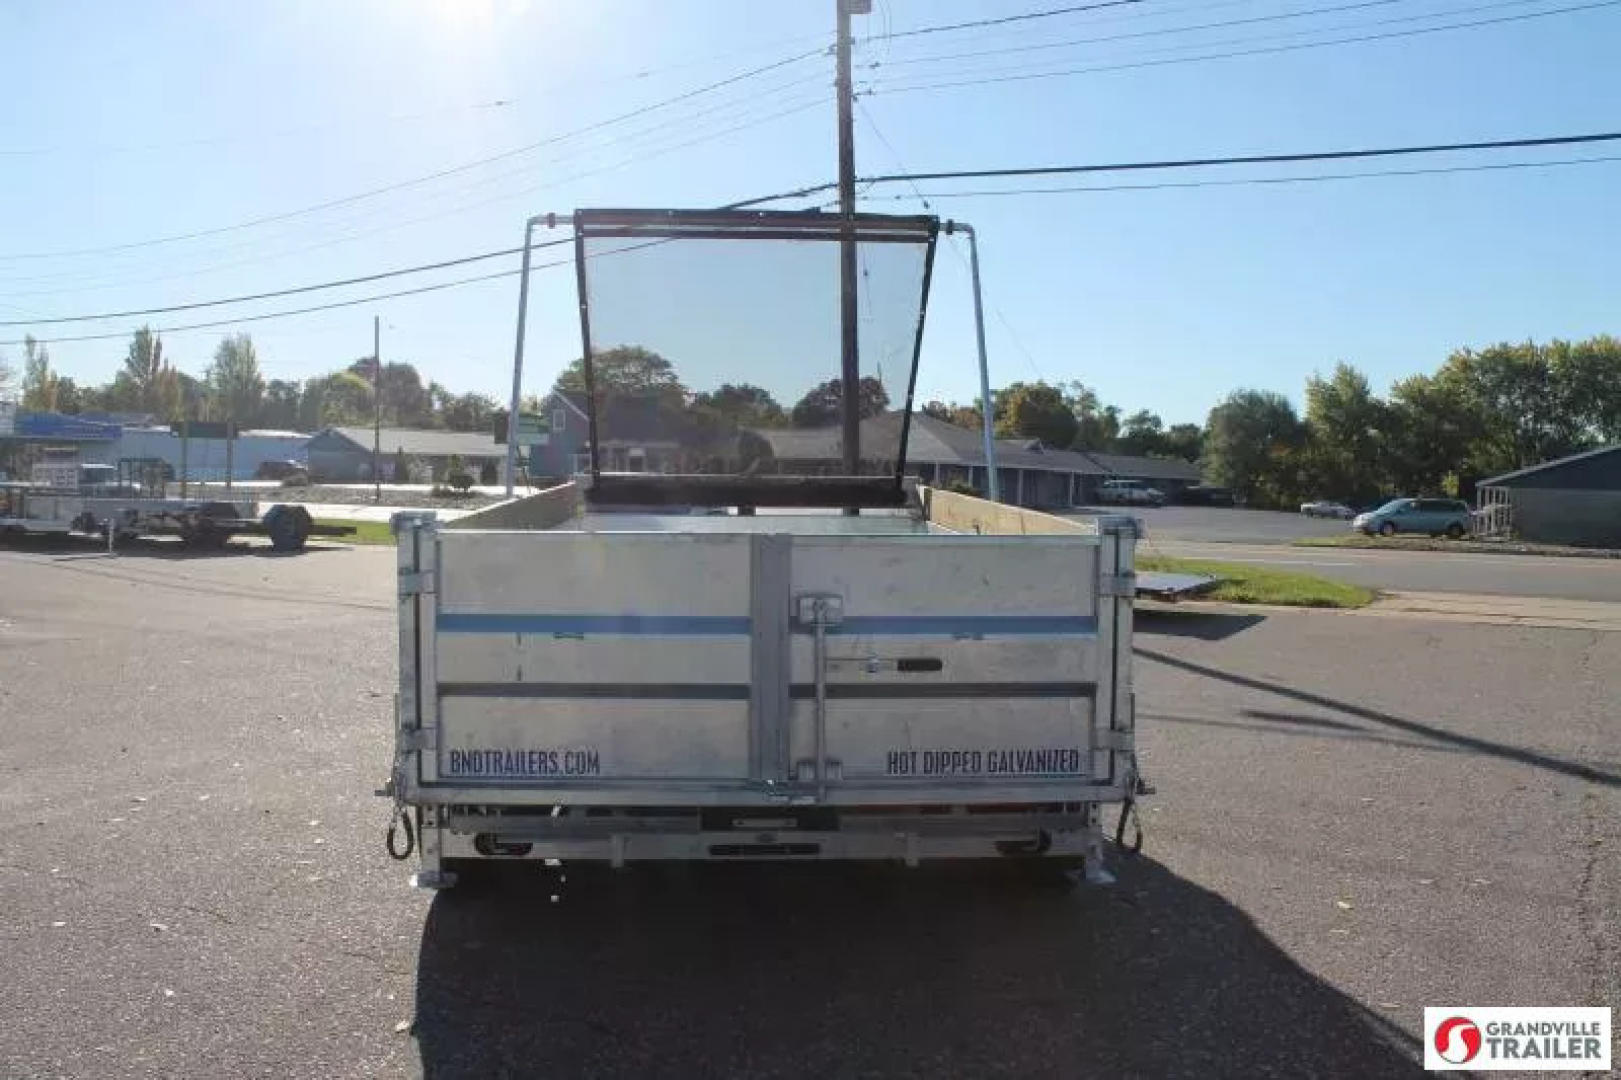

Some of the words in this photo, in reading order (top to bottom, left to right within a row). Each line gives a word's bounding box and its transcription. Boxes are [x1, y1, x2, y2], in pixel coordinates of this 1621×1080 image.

[450, 749, 601, 775] BNDTRAILERS.COM
[888, 750, 917, 775] HOT
[923, 750, 982, 775] DIPPED
[988, 748, 1079, 774] GALVANIZED
